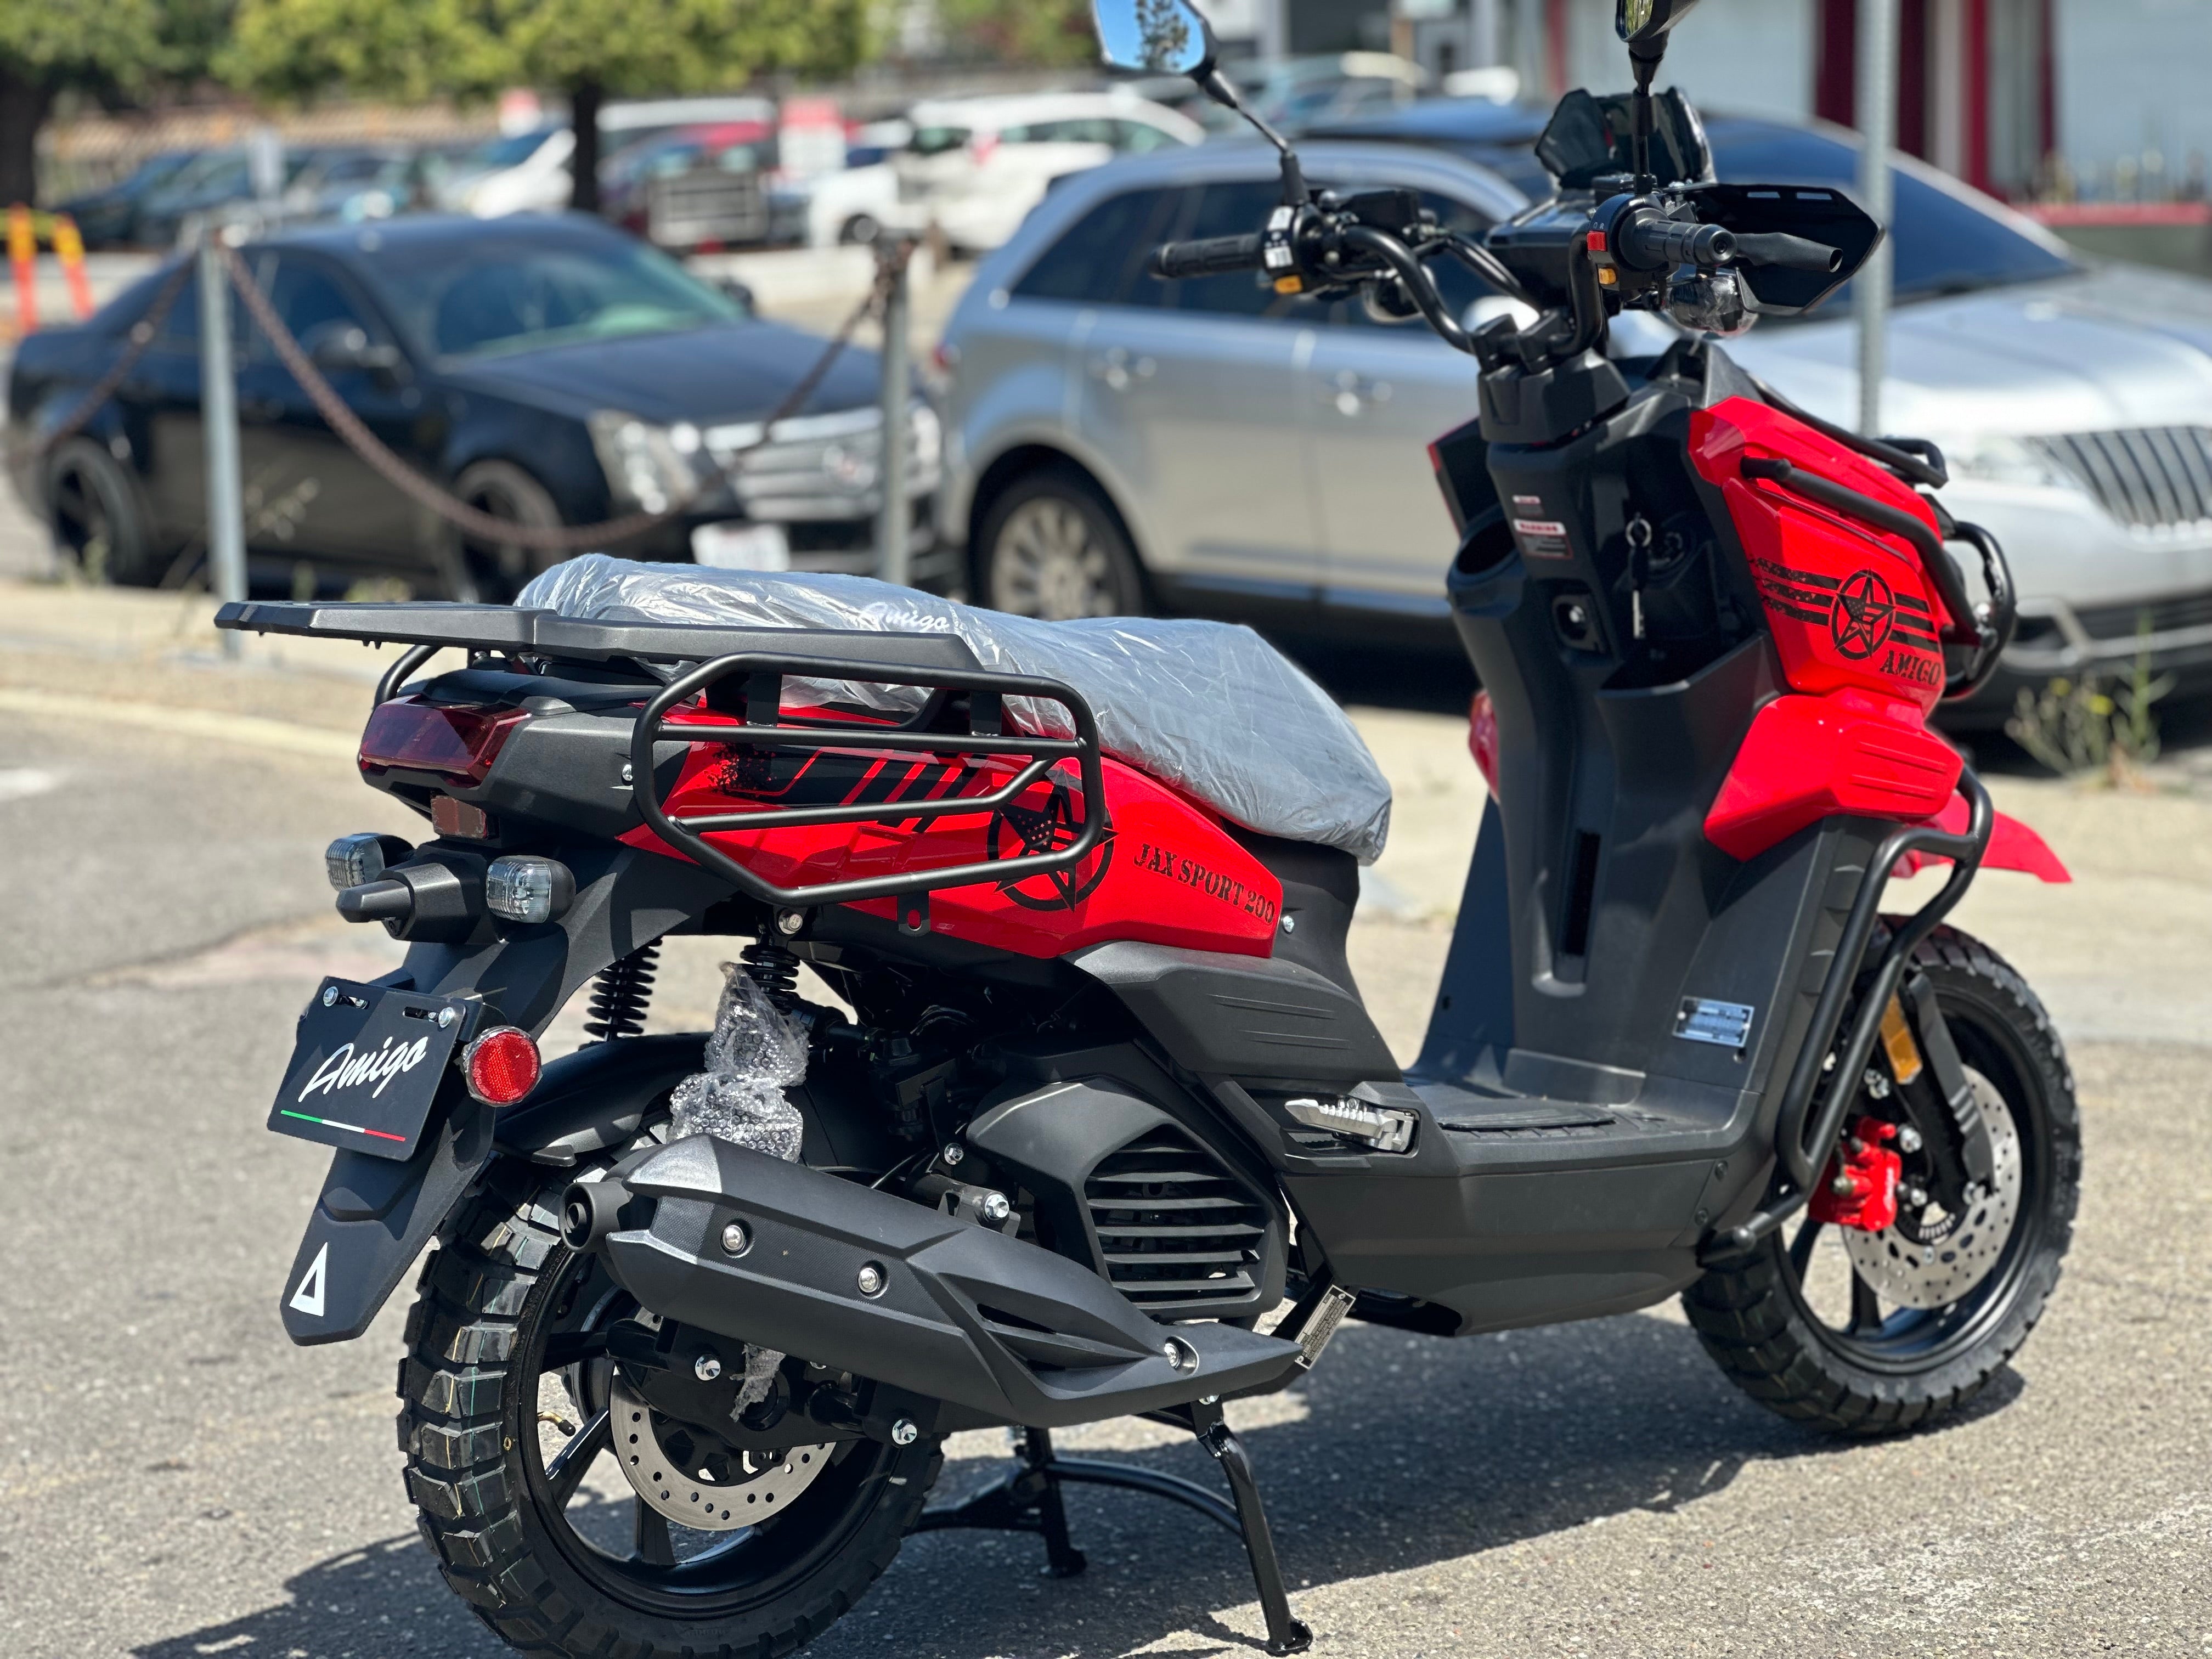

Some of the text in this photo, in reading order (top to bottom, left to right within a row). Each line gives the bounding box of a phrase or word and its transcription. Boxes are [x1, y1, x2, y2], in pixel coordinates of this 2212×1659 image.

[1879, 649, 1942, 686] AMIGO
[1133, 843, 1277, 924] JAX SPORT 200
[297, 1036, 428, 1103] Amigo
